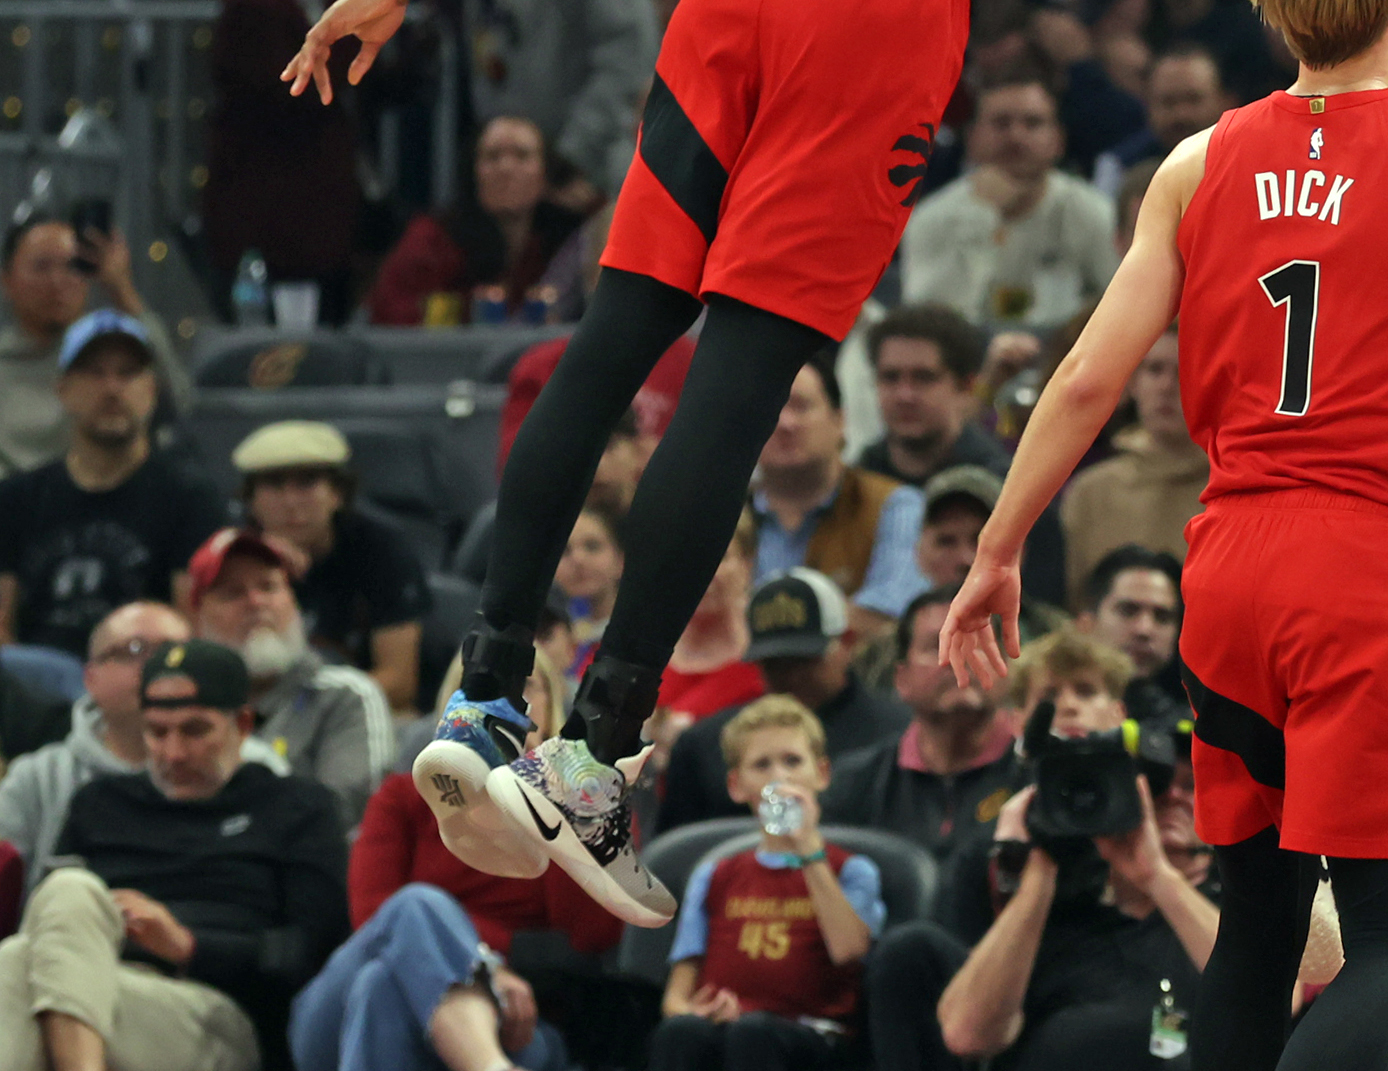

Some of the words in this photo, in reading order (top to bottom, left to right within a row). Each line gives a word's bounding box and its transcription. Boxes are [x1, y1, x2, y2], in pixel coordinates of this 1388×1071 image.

[1255, 169, 1355, 226] DICK
[1258, 259, 1320, 417] 1
[738, 920, 792, 961] 45
